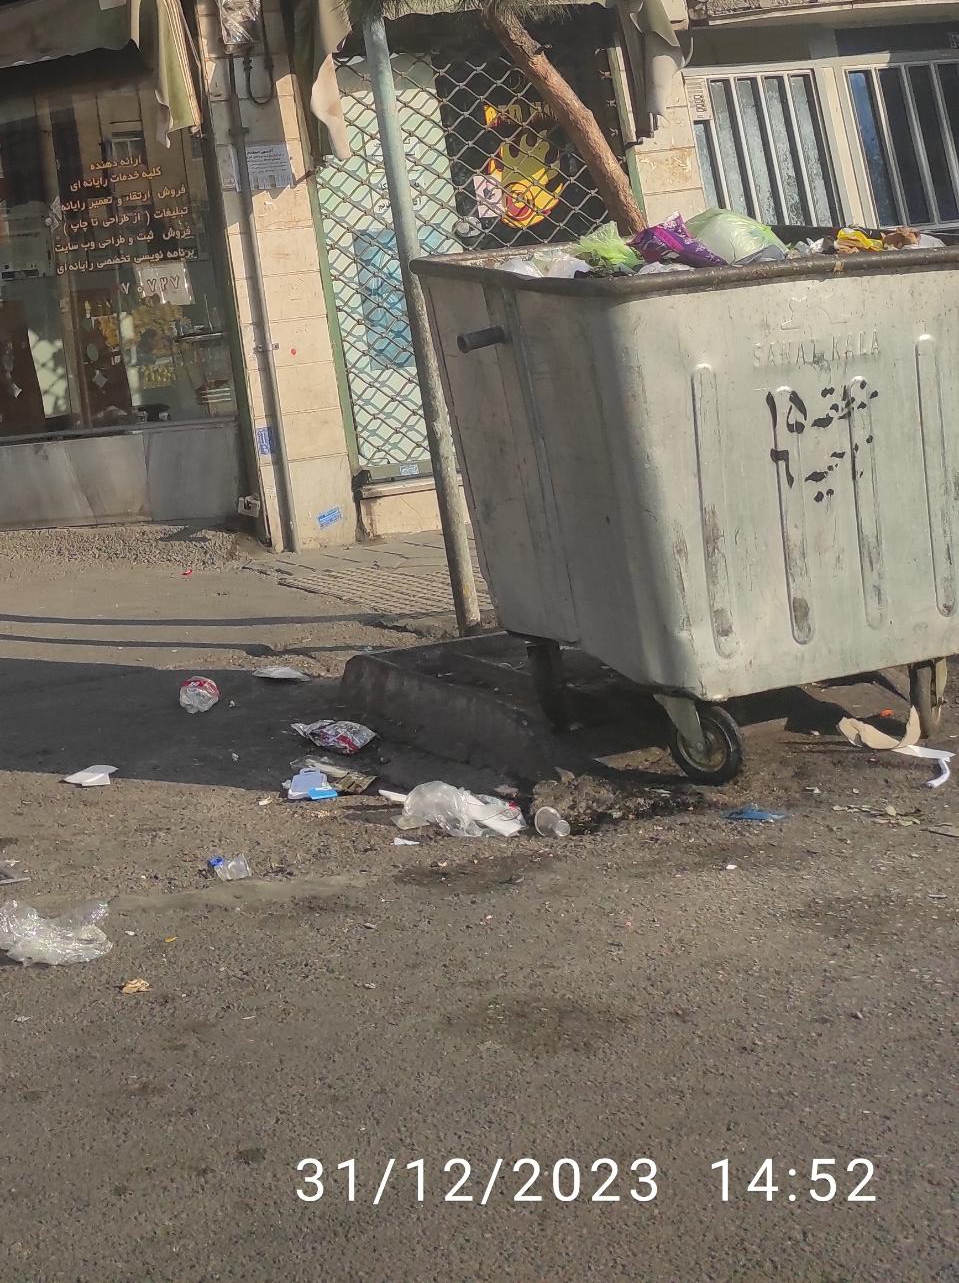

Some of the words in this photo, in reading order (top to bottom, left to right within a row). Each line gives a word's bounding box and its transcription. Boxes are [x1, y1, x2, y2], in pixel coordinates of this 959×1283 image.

[110, 171, 140, 183] خدمات
[141, 167, 162, 180] کلیه
[157, 184, 186, 200] فروش
[61, 200, 86, 212] رایانه
[89, 196, 113, 209] تعمیر
[117, 198, 123, 206] و
[102, 211, 130, 227] طراحی
[153, 207, 189, 219] تبلیغات
[91, 217, 99, 227] تا
[136, 230, 154, 242] ثبت
[162, 225, 192, 241] فروش
[54, 241, 79, 254] سایت
[81, 240, 96, 251] وب
[98, 234, 126, 249] طراحی
[128, 237, 134, 246] و
[134, 251, 164, 264] نویسی
[166, 248, 195, 259] برنامه
[96, 255, 131, 269] تخصصی
